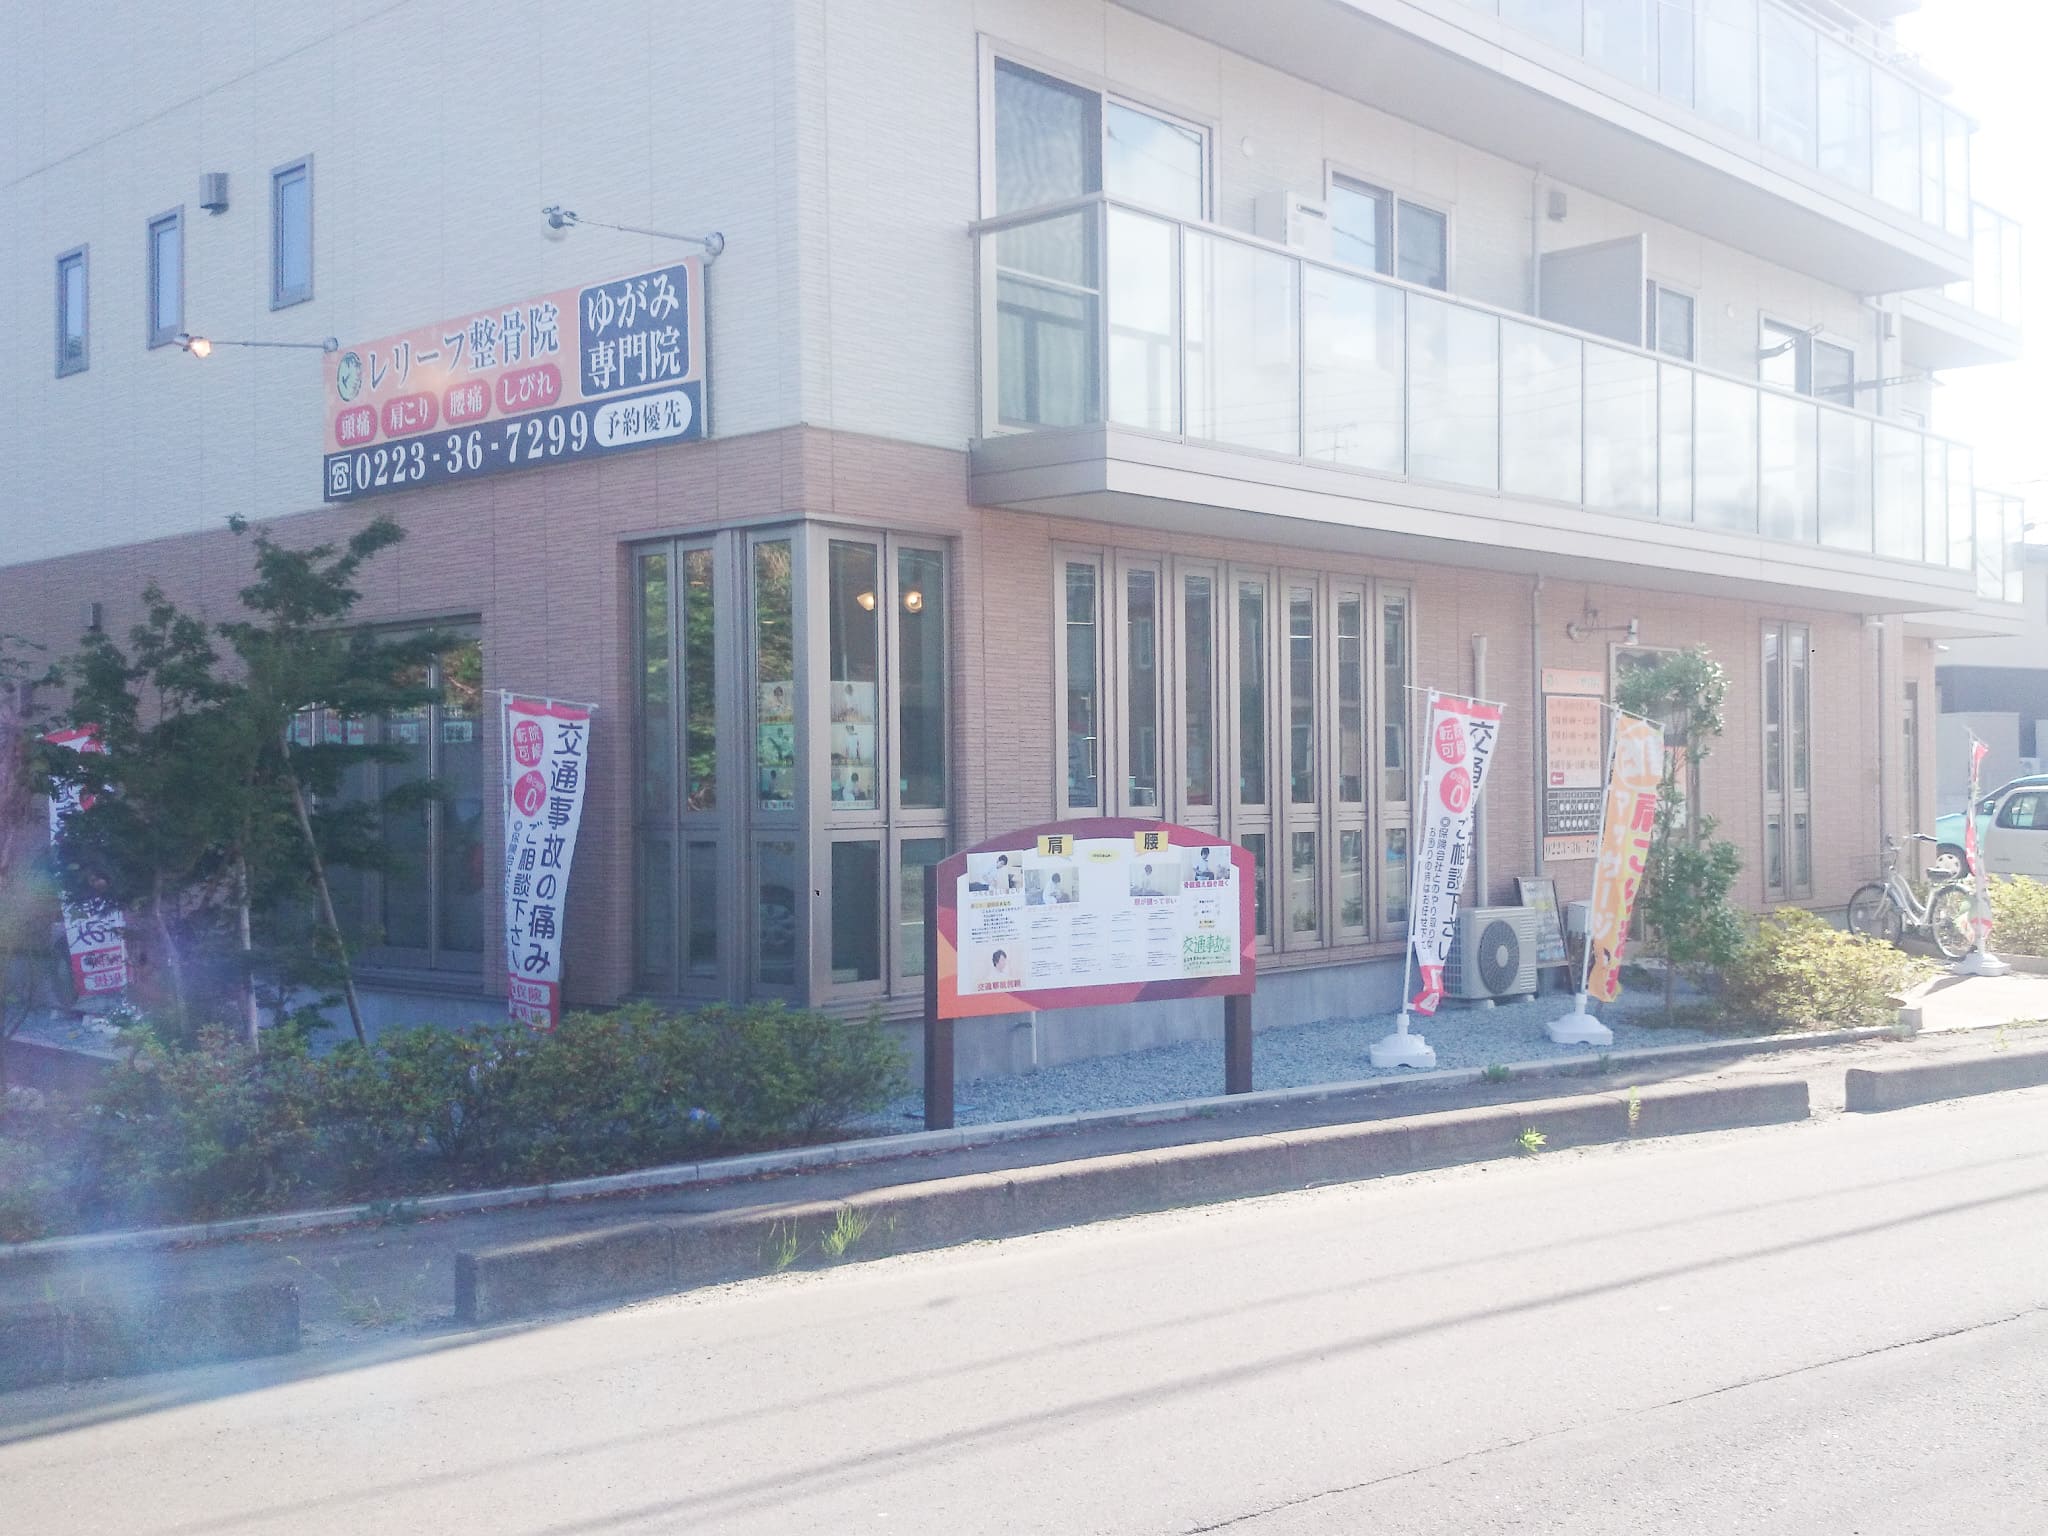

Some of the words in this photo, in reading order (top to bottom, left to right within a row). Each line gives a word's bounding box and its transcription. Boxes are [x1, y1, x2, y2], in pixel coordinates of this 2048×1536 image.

[588, 273, 679, 337] ゆがみ
[369, 302, 559, 390] レリーフ整骨院
[588, 326, 681, 389] 専門院
[450, 385, 482, 417] 腰痛
[503, 370, 554, 406] しびれ
[341, 411, 370, 441] 頭痛
[390, 397, 429, 430] 肩こり
[606, 399, 682, 440] 予約優先
[523, 722, 584, 974] 交通事故の痛み
[1047, 836, 1064, 854] 肩
[1144, 832, 1159, 850] 腰
